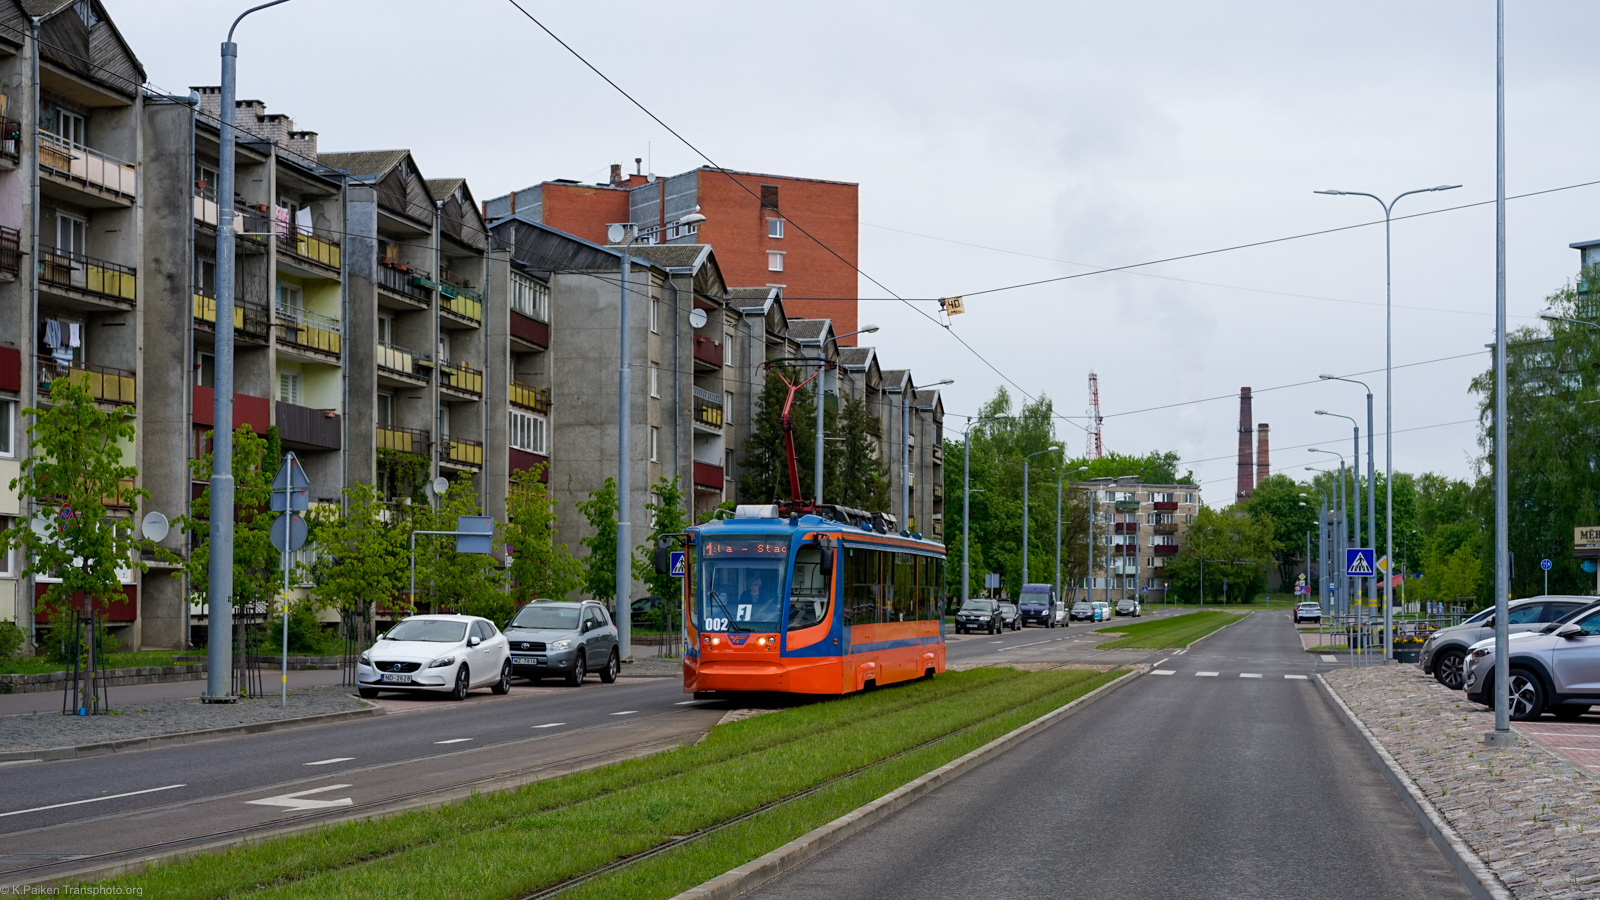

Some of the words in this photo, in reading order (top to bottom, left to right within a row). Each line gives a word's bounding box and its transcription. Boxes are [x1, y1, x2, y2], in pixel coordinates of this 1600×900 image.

[948, 299, 960, 309] 40
[706, 542, 714, 556] 1
[705, 617, 728, 631] 002
[384, 674, 411, 682] ND-2628
